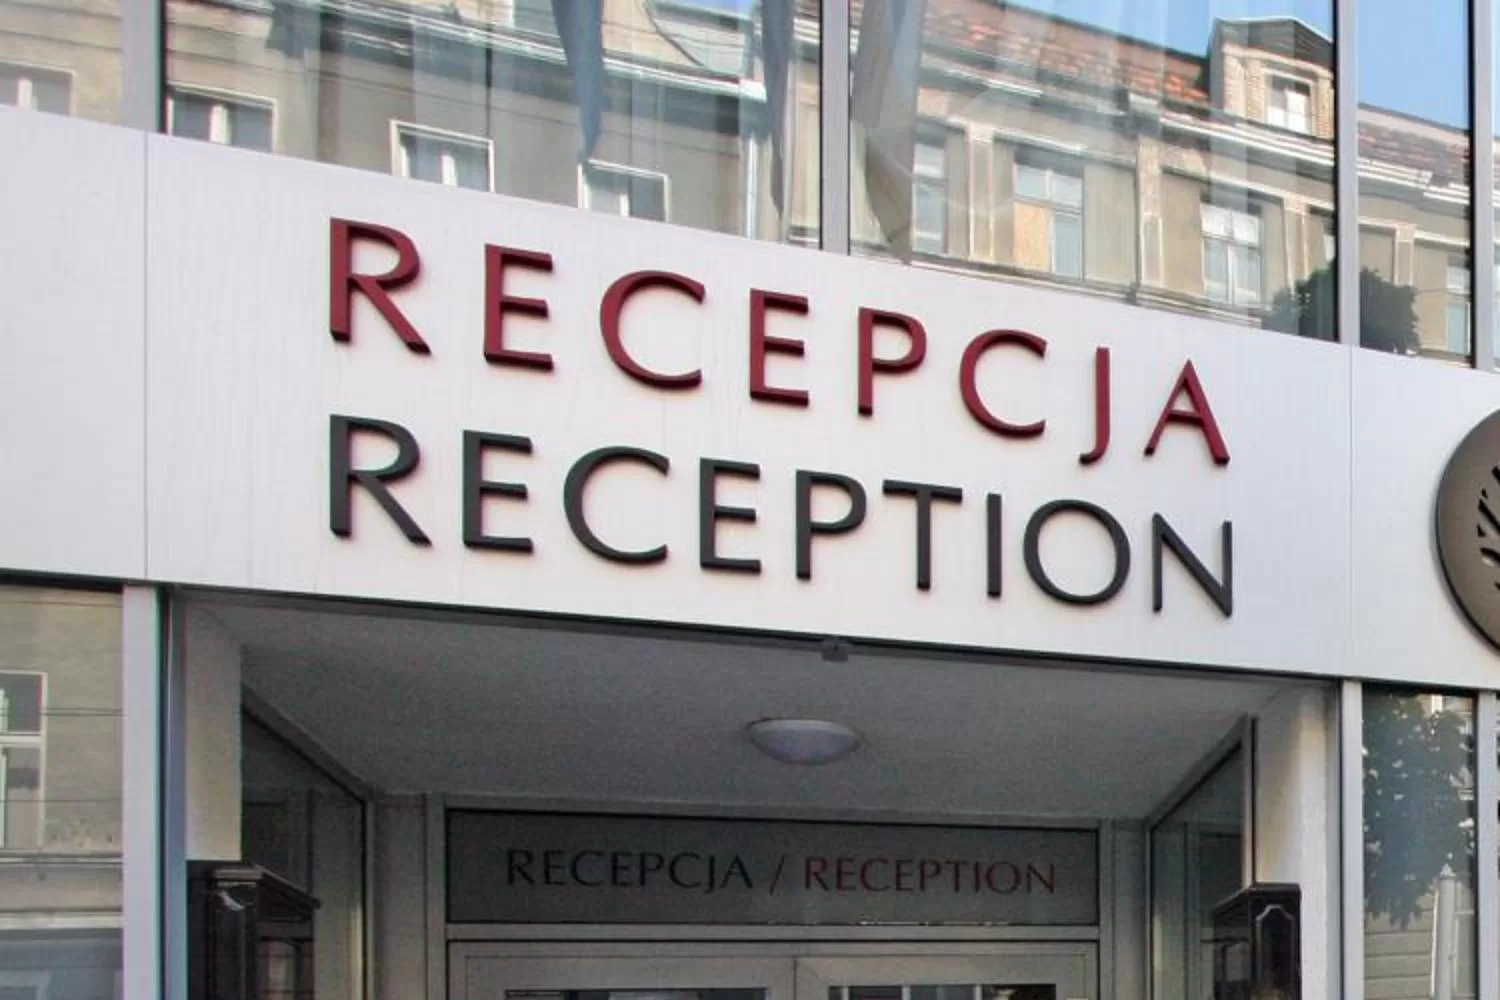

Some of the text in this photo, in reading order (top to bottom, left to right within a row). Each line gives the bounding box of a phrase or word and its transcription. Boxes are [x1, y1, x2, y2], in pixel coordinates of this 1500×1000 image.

[329, 218, 1231, 467] RECEPCJA
[329, 413, 1233, 619] RECEPTION
[506, 848, 754, 892] RECEPCJA
[804, 856, 1057, 895] RECEPTION
